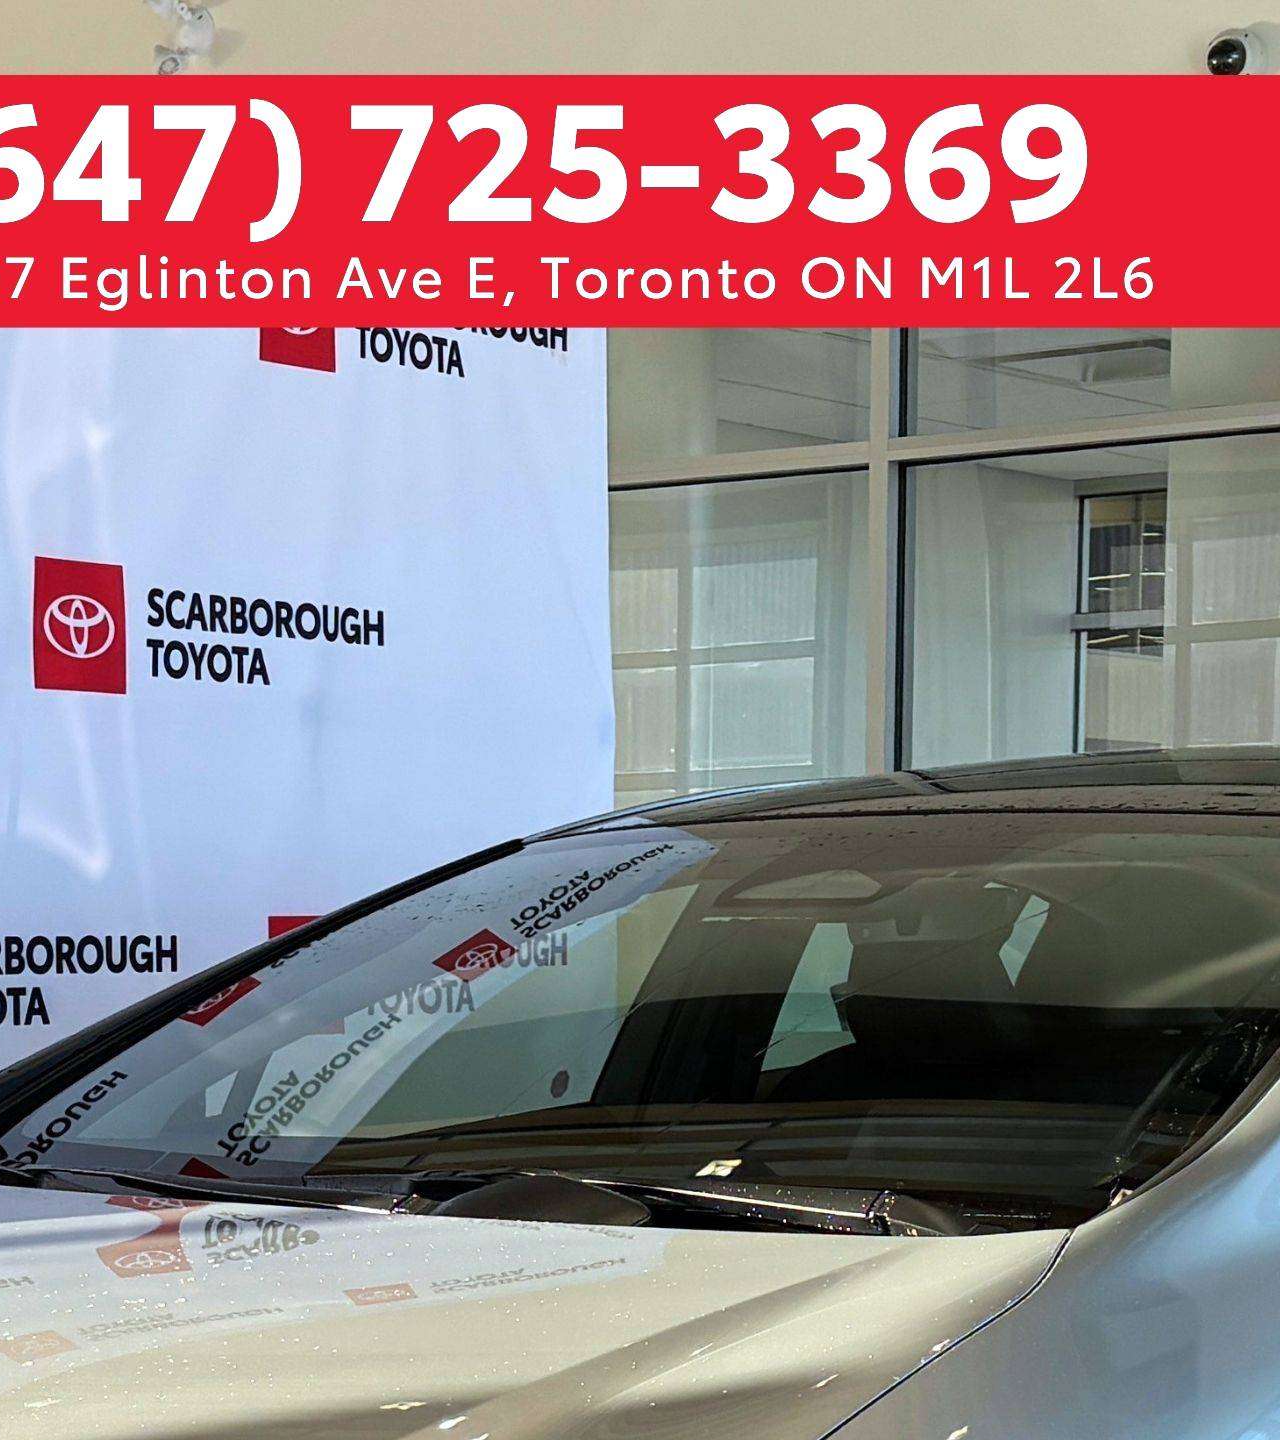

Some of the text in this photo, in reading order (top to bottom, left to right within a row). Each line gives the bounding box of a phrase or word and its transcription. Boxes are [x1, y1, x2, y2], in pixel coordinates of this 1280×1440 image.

[354, 327, 465, 378] TOYOTA
[147, 588, 386, 648] SCARBOROUGH
[146, 637, 271, 686] TOYOTA
